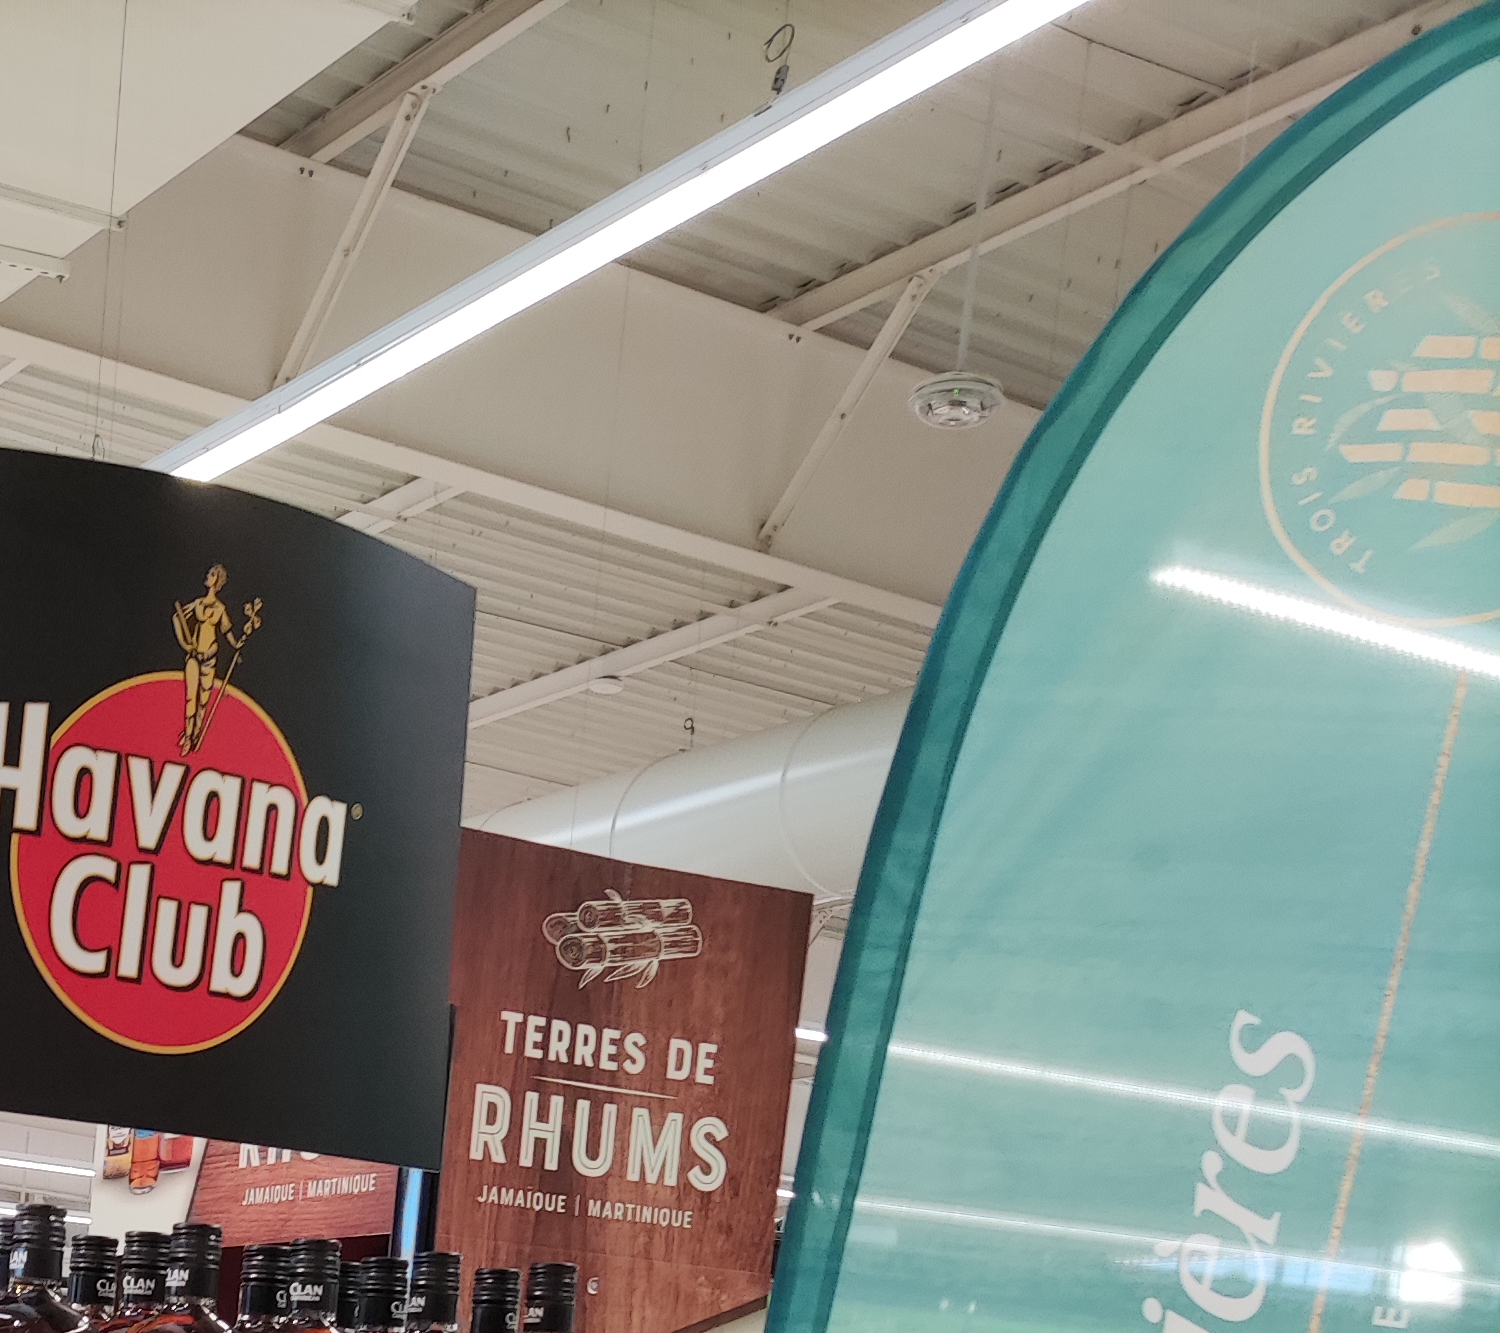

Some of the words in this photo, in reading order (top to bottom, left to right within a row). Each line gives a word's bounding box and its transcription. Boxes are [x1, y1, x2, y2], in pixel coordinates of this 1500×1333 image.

[1291, 466, 1374, 574] TROIS
[49, 854, 268, 999] Club
[500, 1010, 649, 1077] TERRES
[665, 1038, 720, 1086] DE
[469, 1083, 730, 1193] RHUMS
[307, 1175, 376, 1198] MARTINIQUE
[476, 1183, 569, 1219] JAMAÏQUE
[586, 1196, 695, 1230] MARTINIQUE
